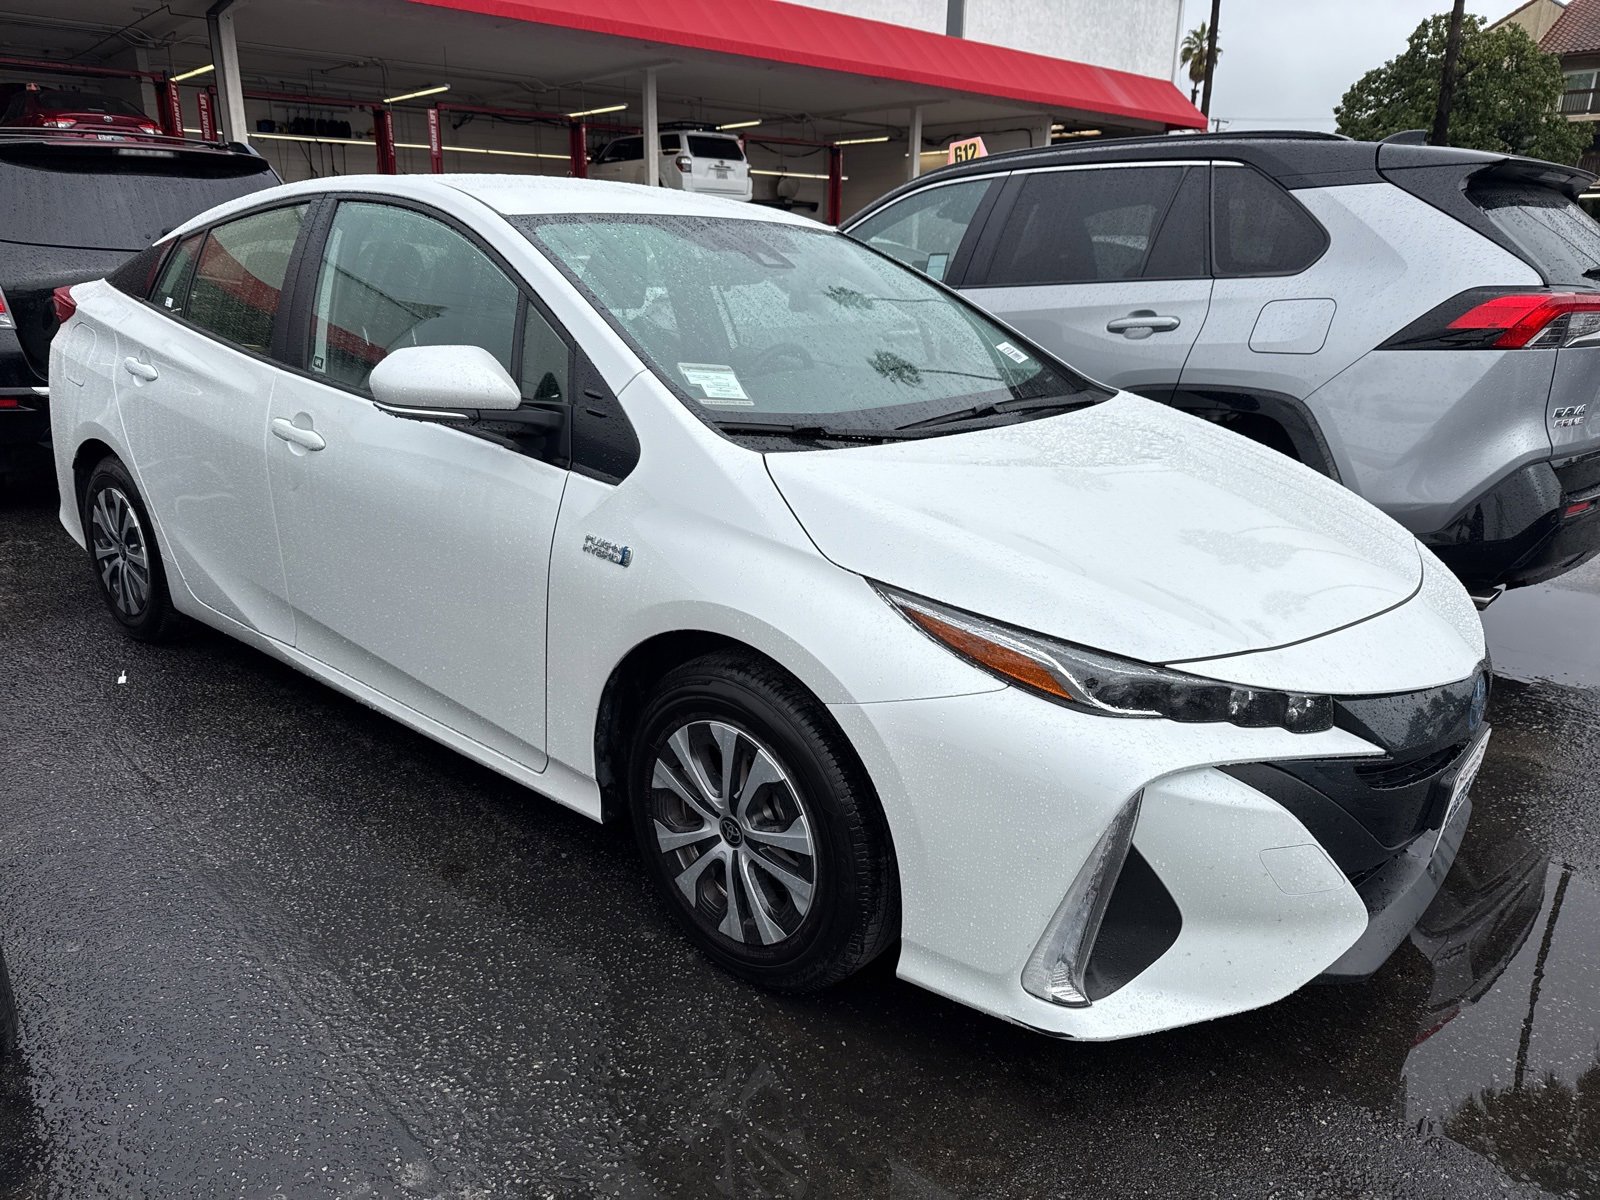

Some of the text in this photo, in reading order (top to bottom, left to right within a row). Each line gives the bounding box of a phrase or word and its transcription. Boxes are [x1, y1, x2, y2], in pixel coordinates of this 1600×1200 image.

[170, 83, 182, 133] ROTARY LIFT
[199, 93, 210, 139] ROTARY LIFT
[429, 109, 438, 151] ROTARY LIFT
[954, 142, 977, 163] 612
